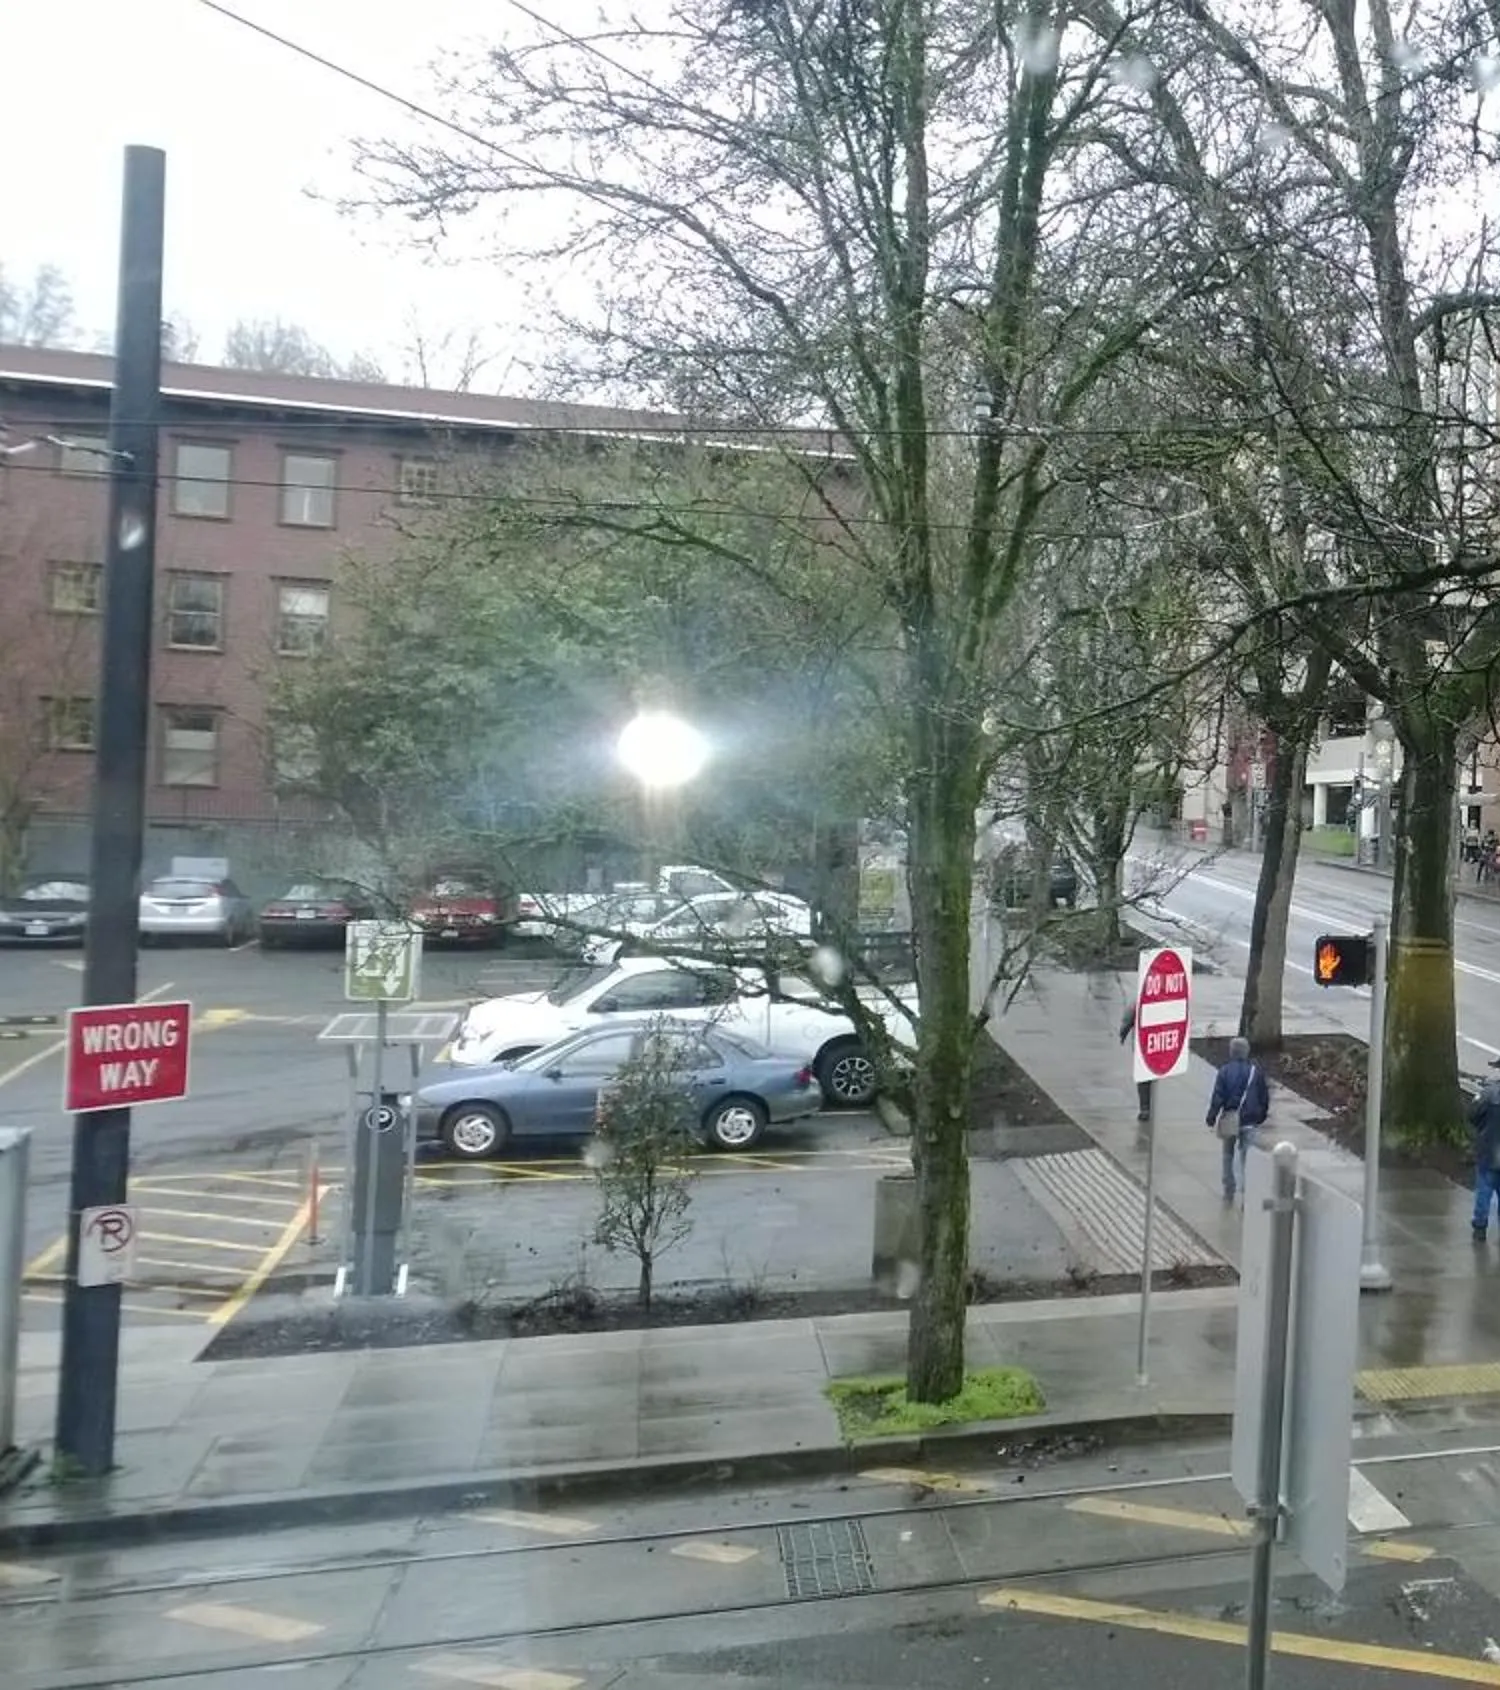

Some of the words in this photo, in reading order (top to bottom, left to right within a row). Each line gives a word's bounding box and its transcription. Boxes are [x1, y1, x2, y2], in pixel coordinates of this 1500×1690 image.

[1146, 975, 1161, 996] DO
[1165, 972, 1184, 994] NOT
[82, 1019, 179, 1055] WRONG
[1147, 1029, 1179, 1054] ENTER
[100, 1058, 159, 1093] WAY
